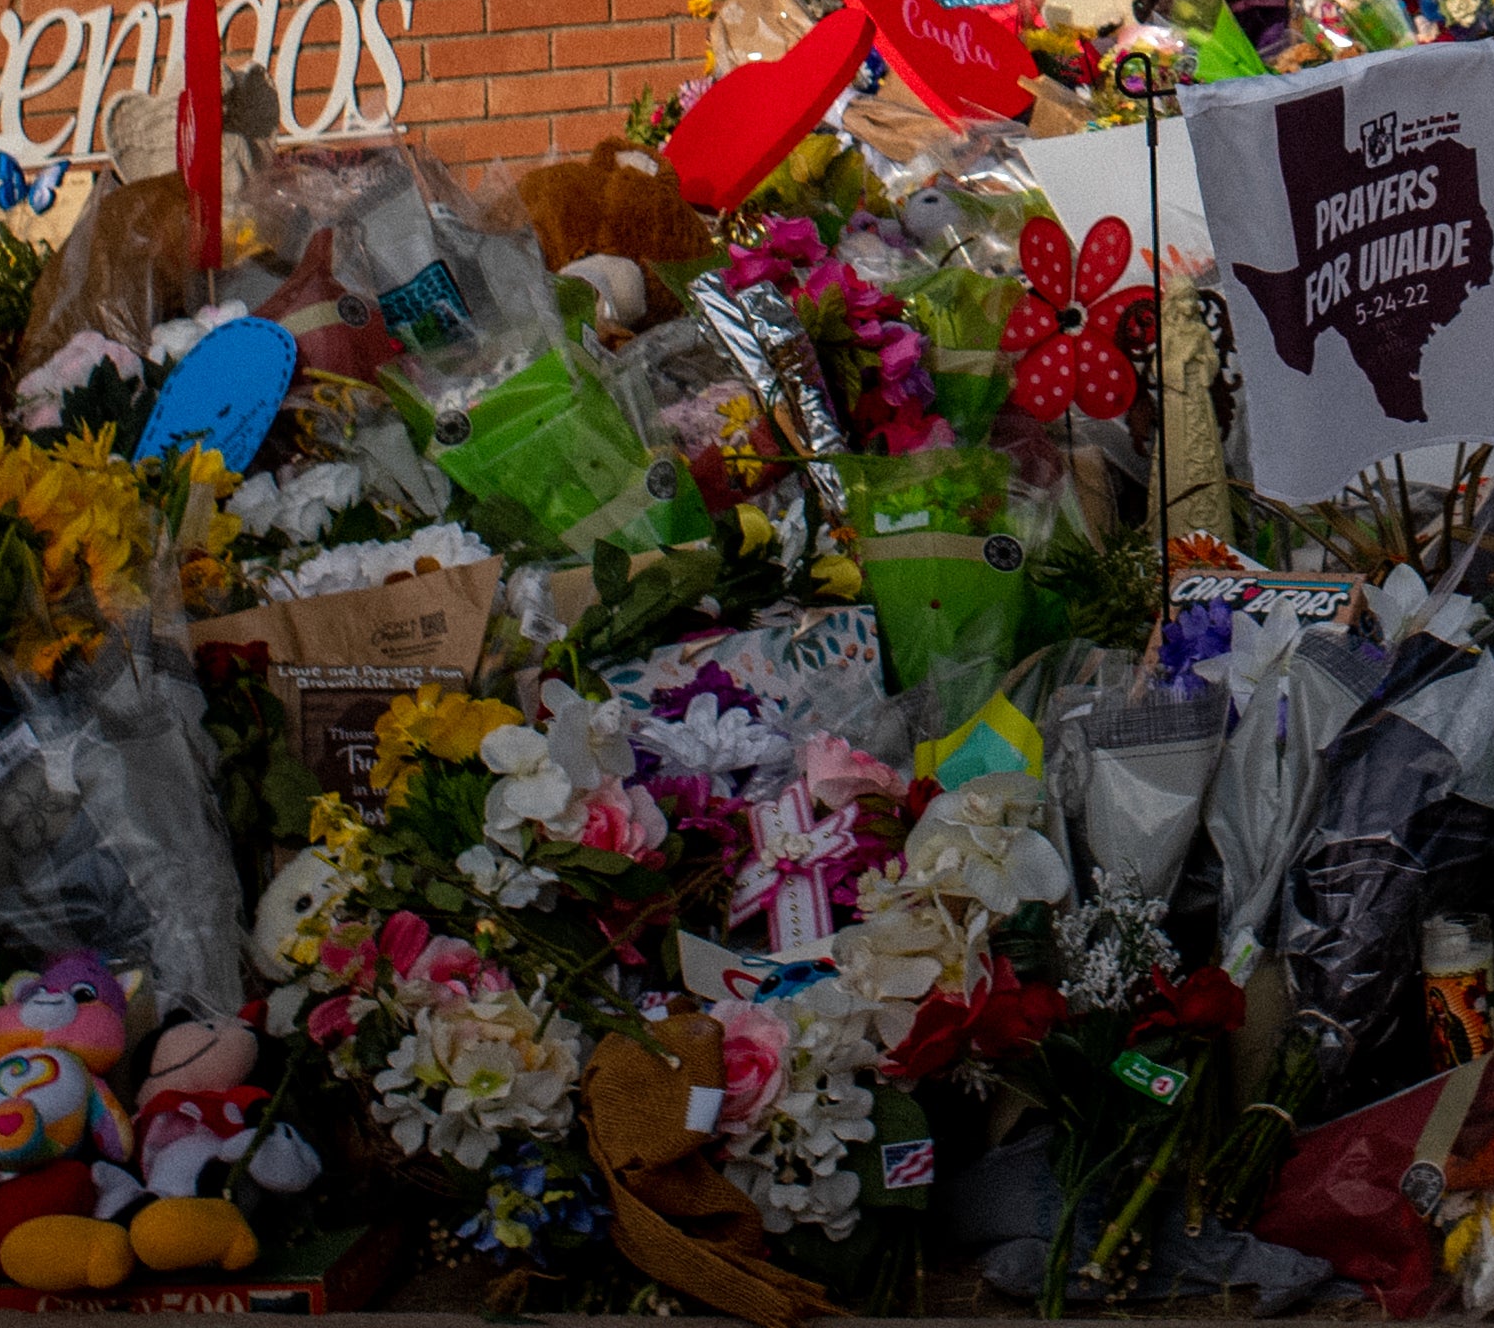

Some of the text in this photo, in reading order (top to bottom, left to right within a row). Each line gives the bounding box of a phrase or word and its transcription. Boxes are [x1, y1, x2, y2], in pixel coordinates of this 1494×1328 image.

[1315, 164, 1439, 251] PRAYERS
[1305, 220, 1472, 327] FOR UVALDE
[1355, 283, 1429, 326] 5-24-22
[1171, 575, 1259, 603] CARE
[327, 665, 358, 678] and
[362, 665, 424, 681] Prayers
[429, 667, 465, 680] from
